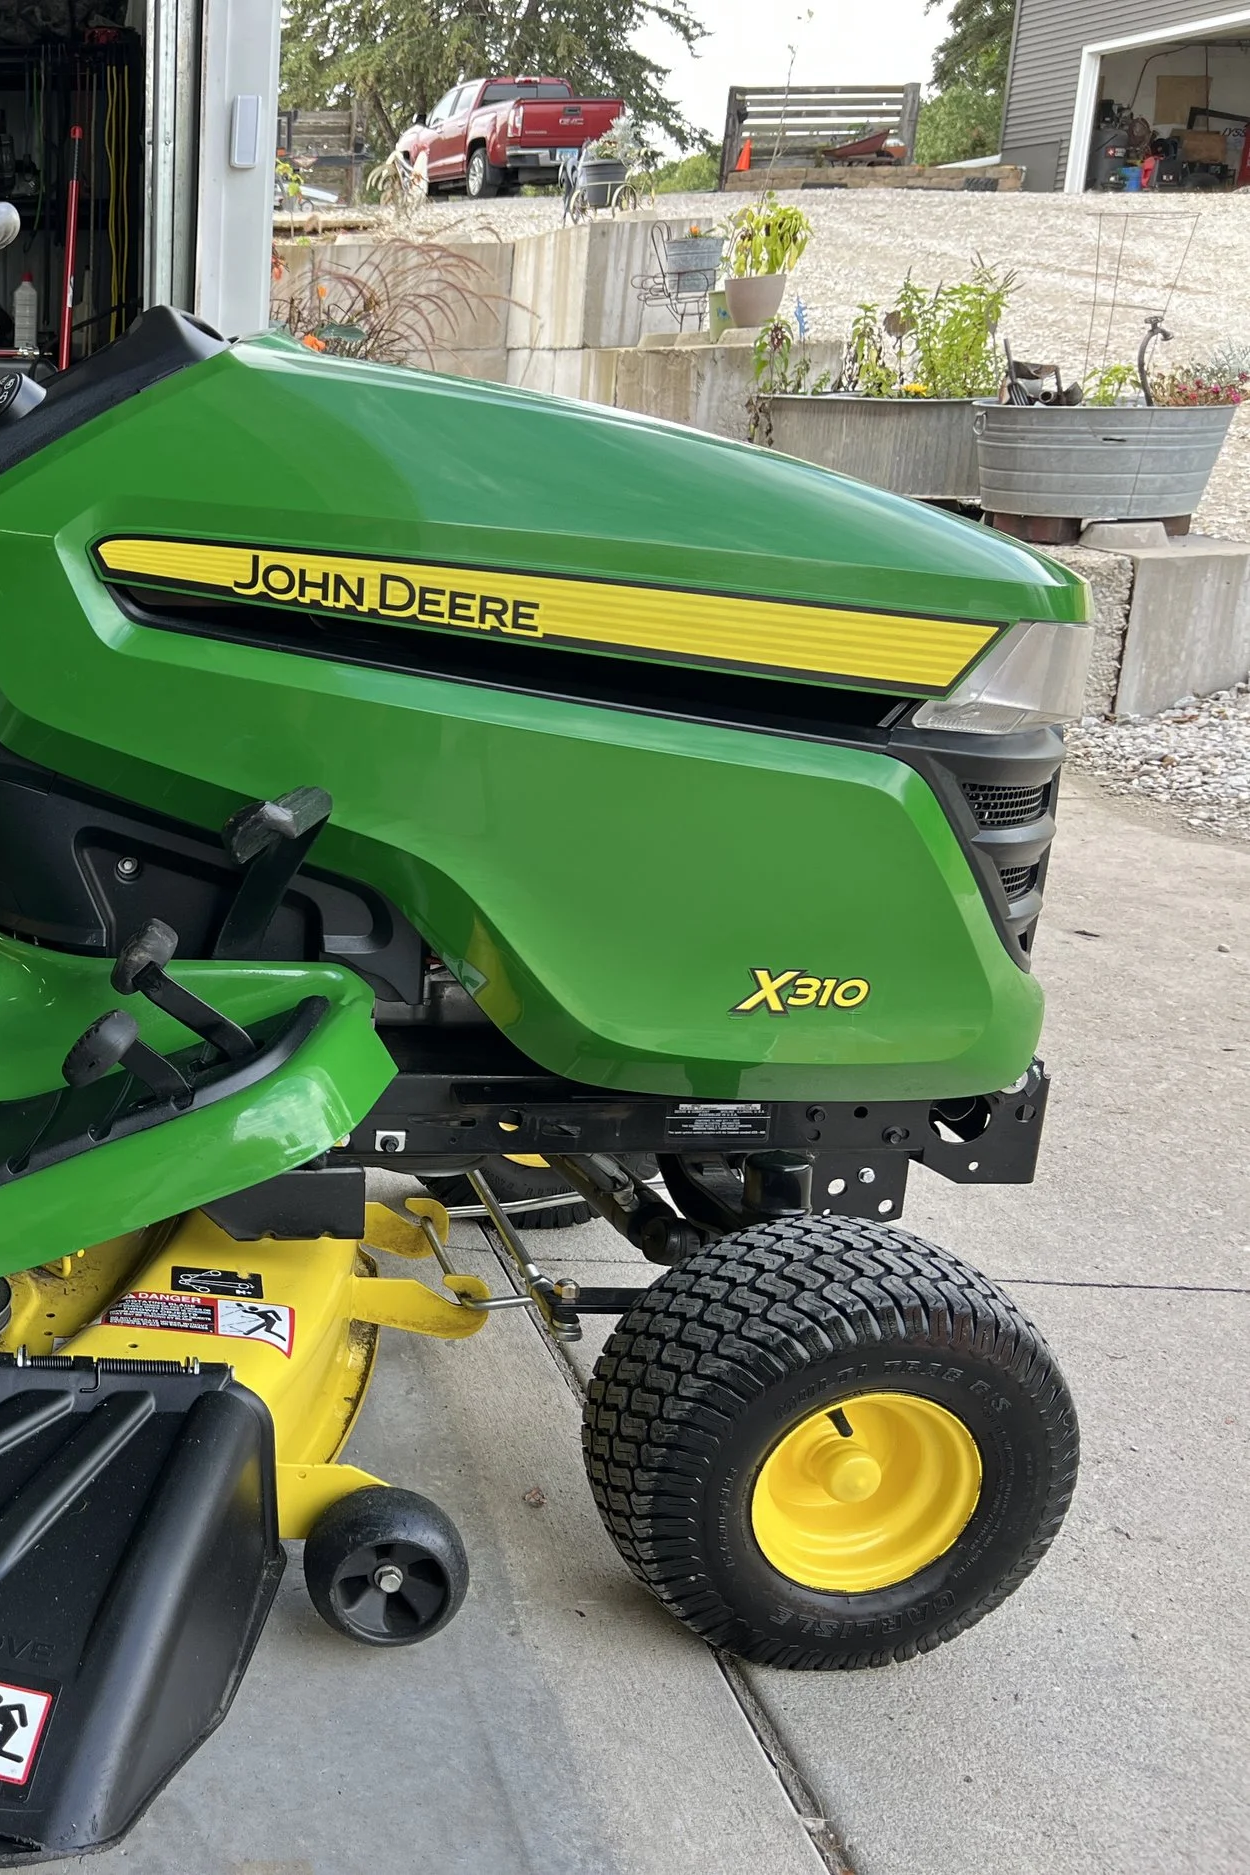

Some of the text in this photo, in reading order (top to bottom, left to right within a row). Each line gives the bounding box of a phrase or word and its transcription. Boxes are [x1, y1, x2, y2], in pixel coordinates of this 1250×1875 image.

[234, 554, 541, 634] JOHN DEERE
[731, 968, 870, 1012] X310
[138, 1292, 201, 1304] DANGER
[768, 1589, 956, 1639] CARLISLE
